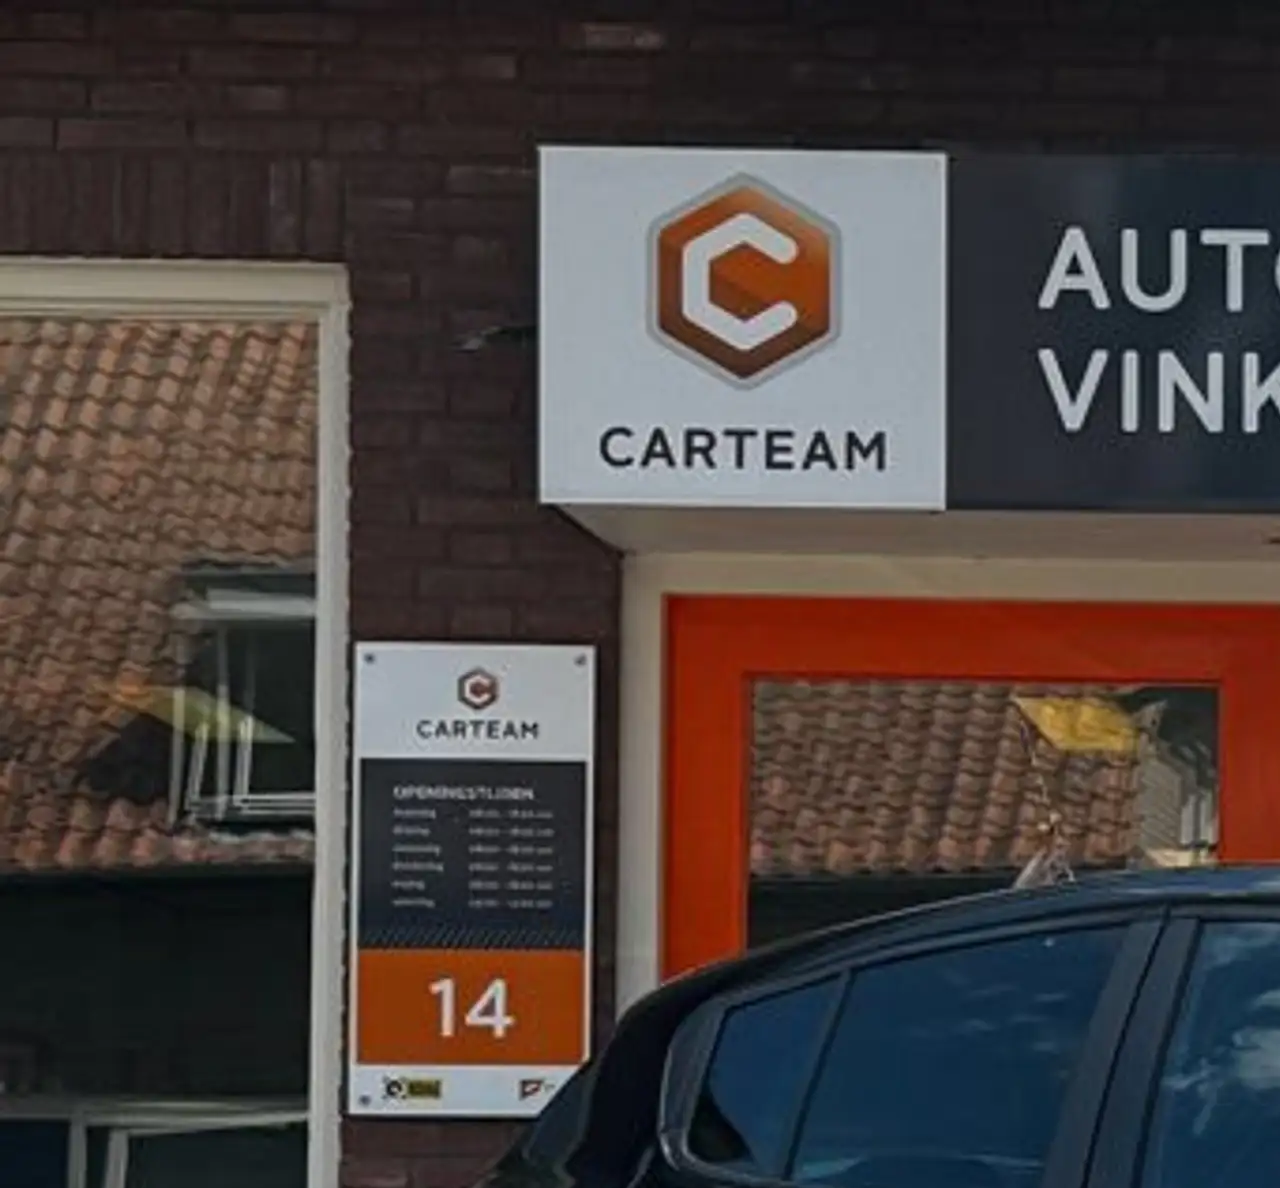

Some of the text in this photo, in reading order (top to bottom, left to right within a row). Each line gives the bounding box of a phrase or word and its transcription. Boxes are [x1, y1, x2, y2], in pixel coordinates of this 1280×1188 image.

[599, 426, 887, 473] CARTEAM
[416, 718, 540, 741] CARTEAM
[428, 976, 515, 1039] 14
